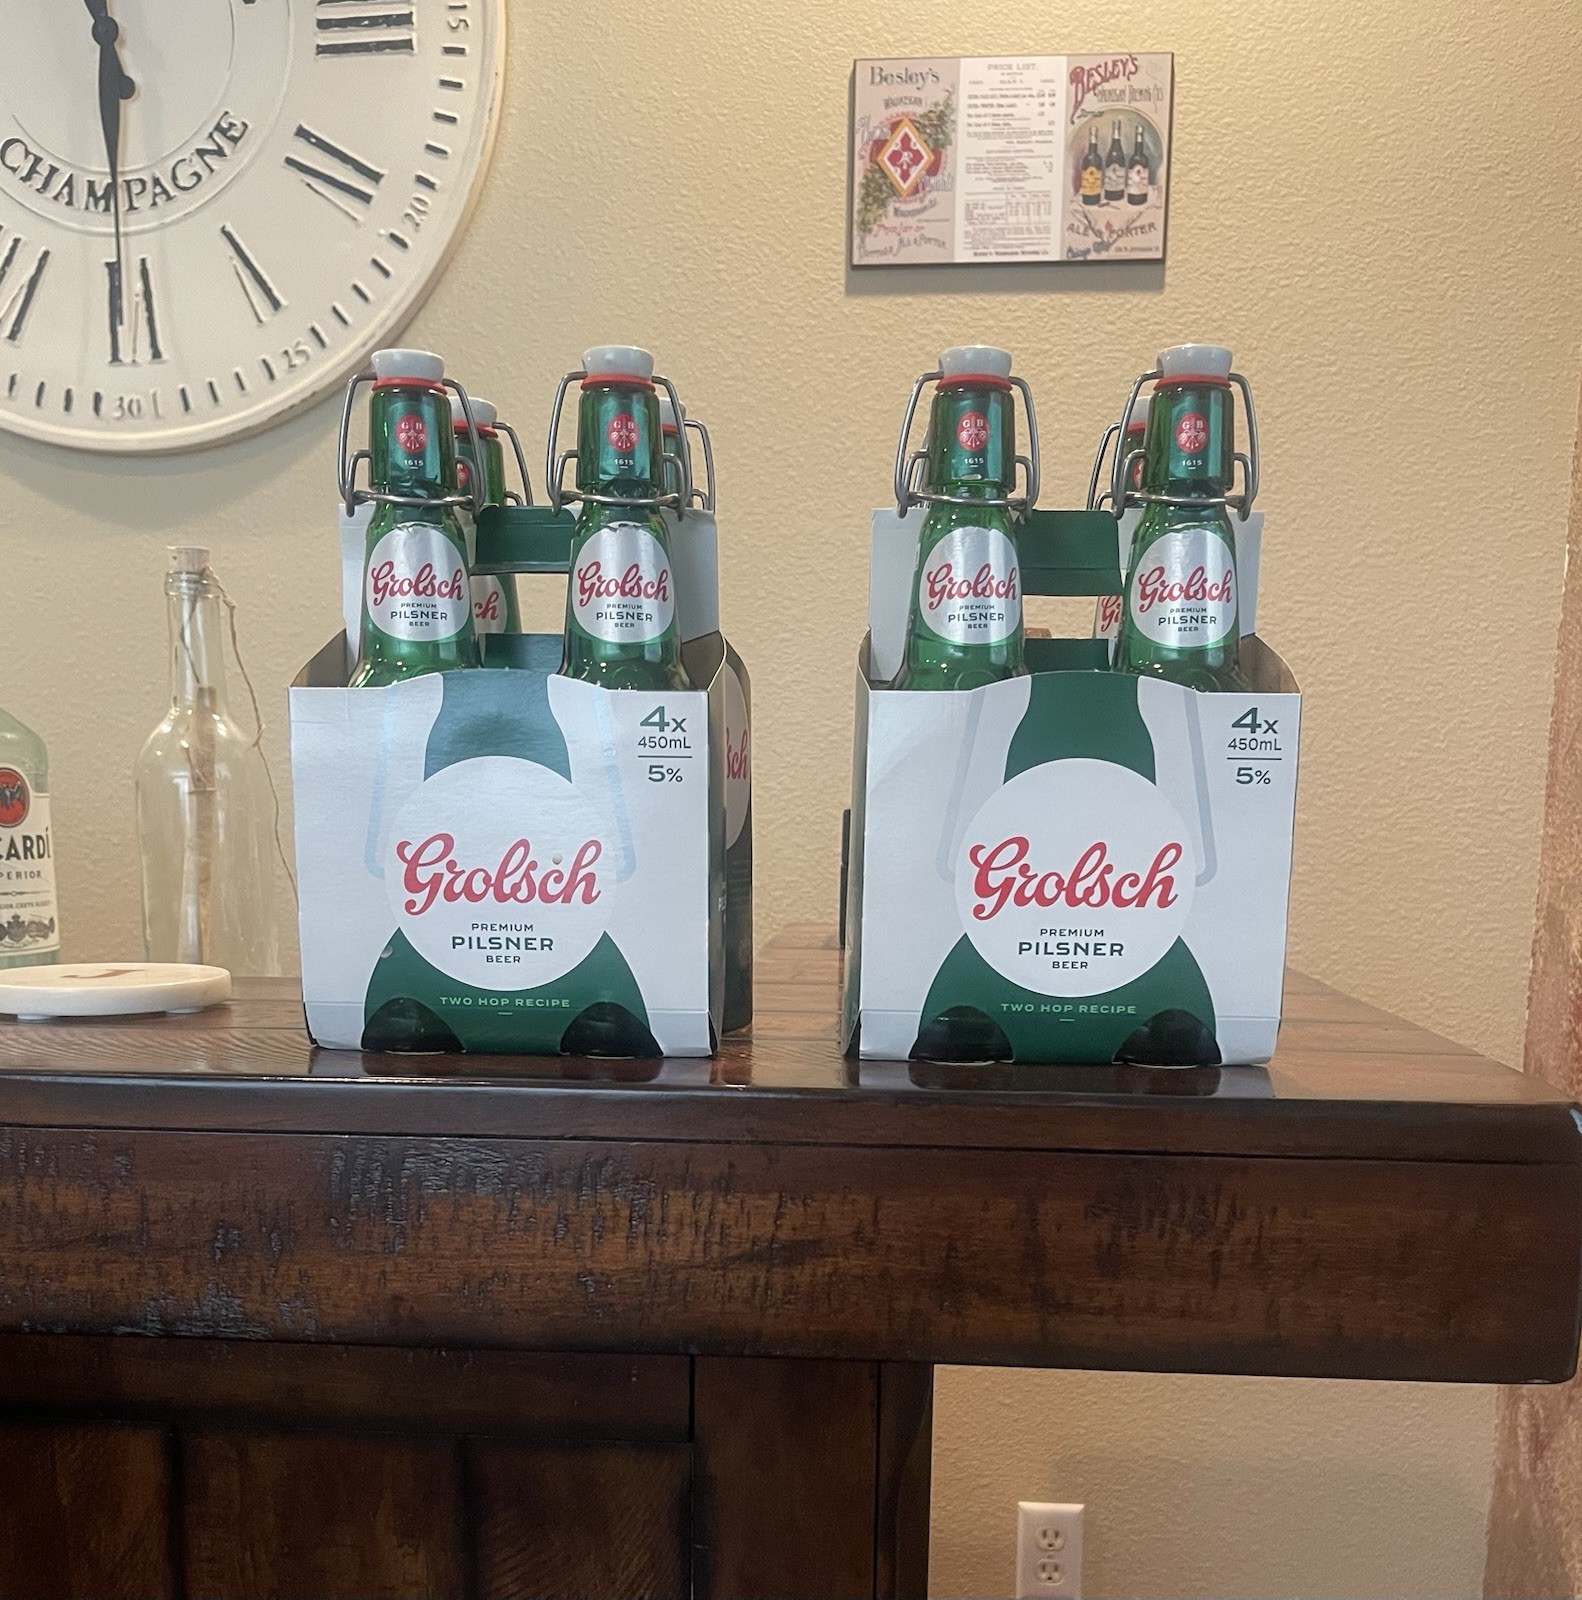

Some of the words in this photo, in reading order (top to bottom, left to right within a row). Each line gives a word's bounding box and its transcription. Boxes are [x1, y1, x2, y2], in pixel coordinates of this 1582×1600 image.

[870, 66, 940, 90] Besley's
[1069, 53, 1139, 125] BESLEY'S
[0, 110, 250, 214] CHAMPAGNE
[403, 196, 431, 229] 20
[283, 339, 312, 374] 25
[403, 459, 424, 467] 1615
[613, 458, 634, 466] 1615
[963, 457, 984, 465] 1615
[1181, 459, 1203, 467] 1615
[371, 560, 465, 606] Grolsch
[577, 561, 669, 607] Grolsch
[926, 563, 1018, 610] Grolsch
[1138, 565, 1233, 613] Grolsch
[390, 610, 448, 621] PILSNER
[596, 611, 653, 622] PILSNER
[947, 612, 1005, 623] PILSNER
[1158, 615, 1217, 626] PILSNER
[639, 705, 688, 733] 4x
[1231, 707, 1279, 734] 4x
[637, 736, 692, 750] 450mL
[1227, 737, 1282, 752] 450mL
[648, 765, 683, 784] 5%
[1235, 767, 1271, 785] 5%
[0, 826, 51, 861] ARDÍ
[0, 870, 42, 881] ERIOR
[396, 832, 602, 917] Grolsch
[969, 836, 1183, 921] Grolsch
[471, 923, 534, 933] PREMIUM
[1039, 928, 1105, 937] PREMIUM
[452, 936, 554, 952] PILSNER
[1018, 941, 1124, 957] PILSNER
[486, 955, 521, 964] BEER
[1052, 960, 1089, 970] BEER
[440, 996, 473, 1006] TWO
[478, 997, 510, 1007] HOP
[515, 998, 571, 1008] RECIPE
[1000, 1002, 1035, 1013] TWO
[1040, 1003, 1073, 1013] HOP
[1078, 1004, 1137, 1015] RECIPE
